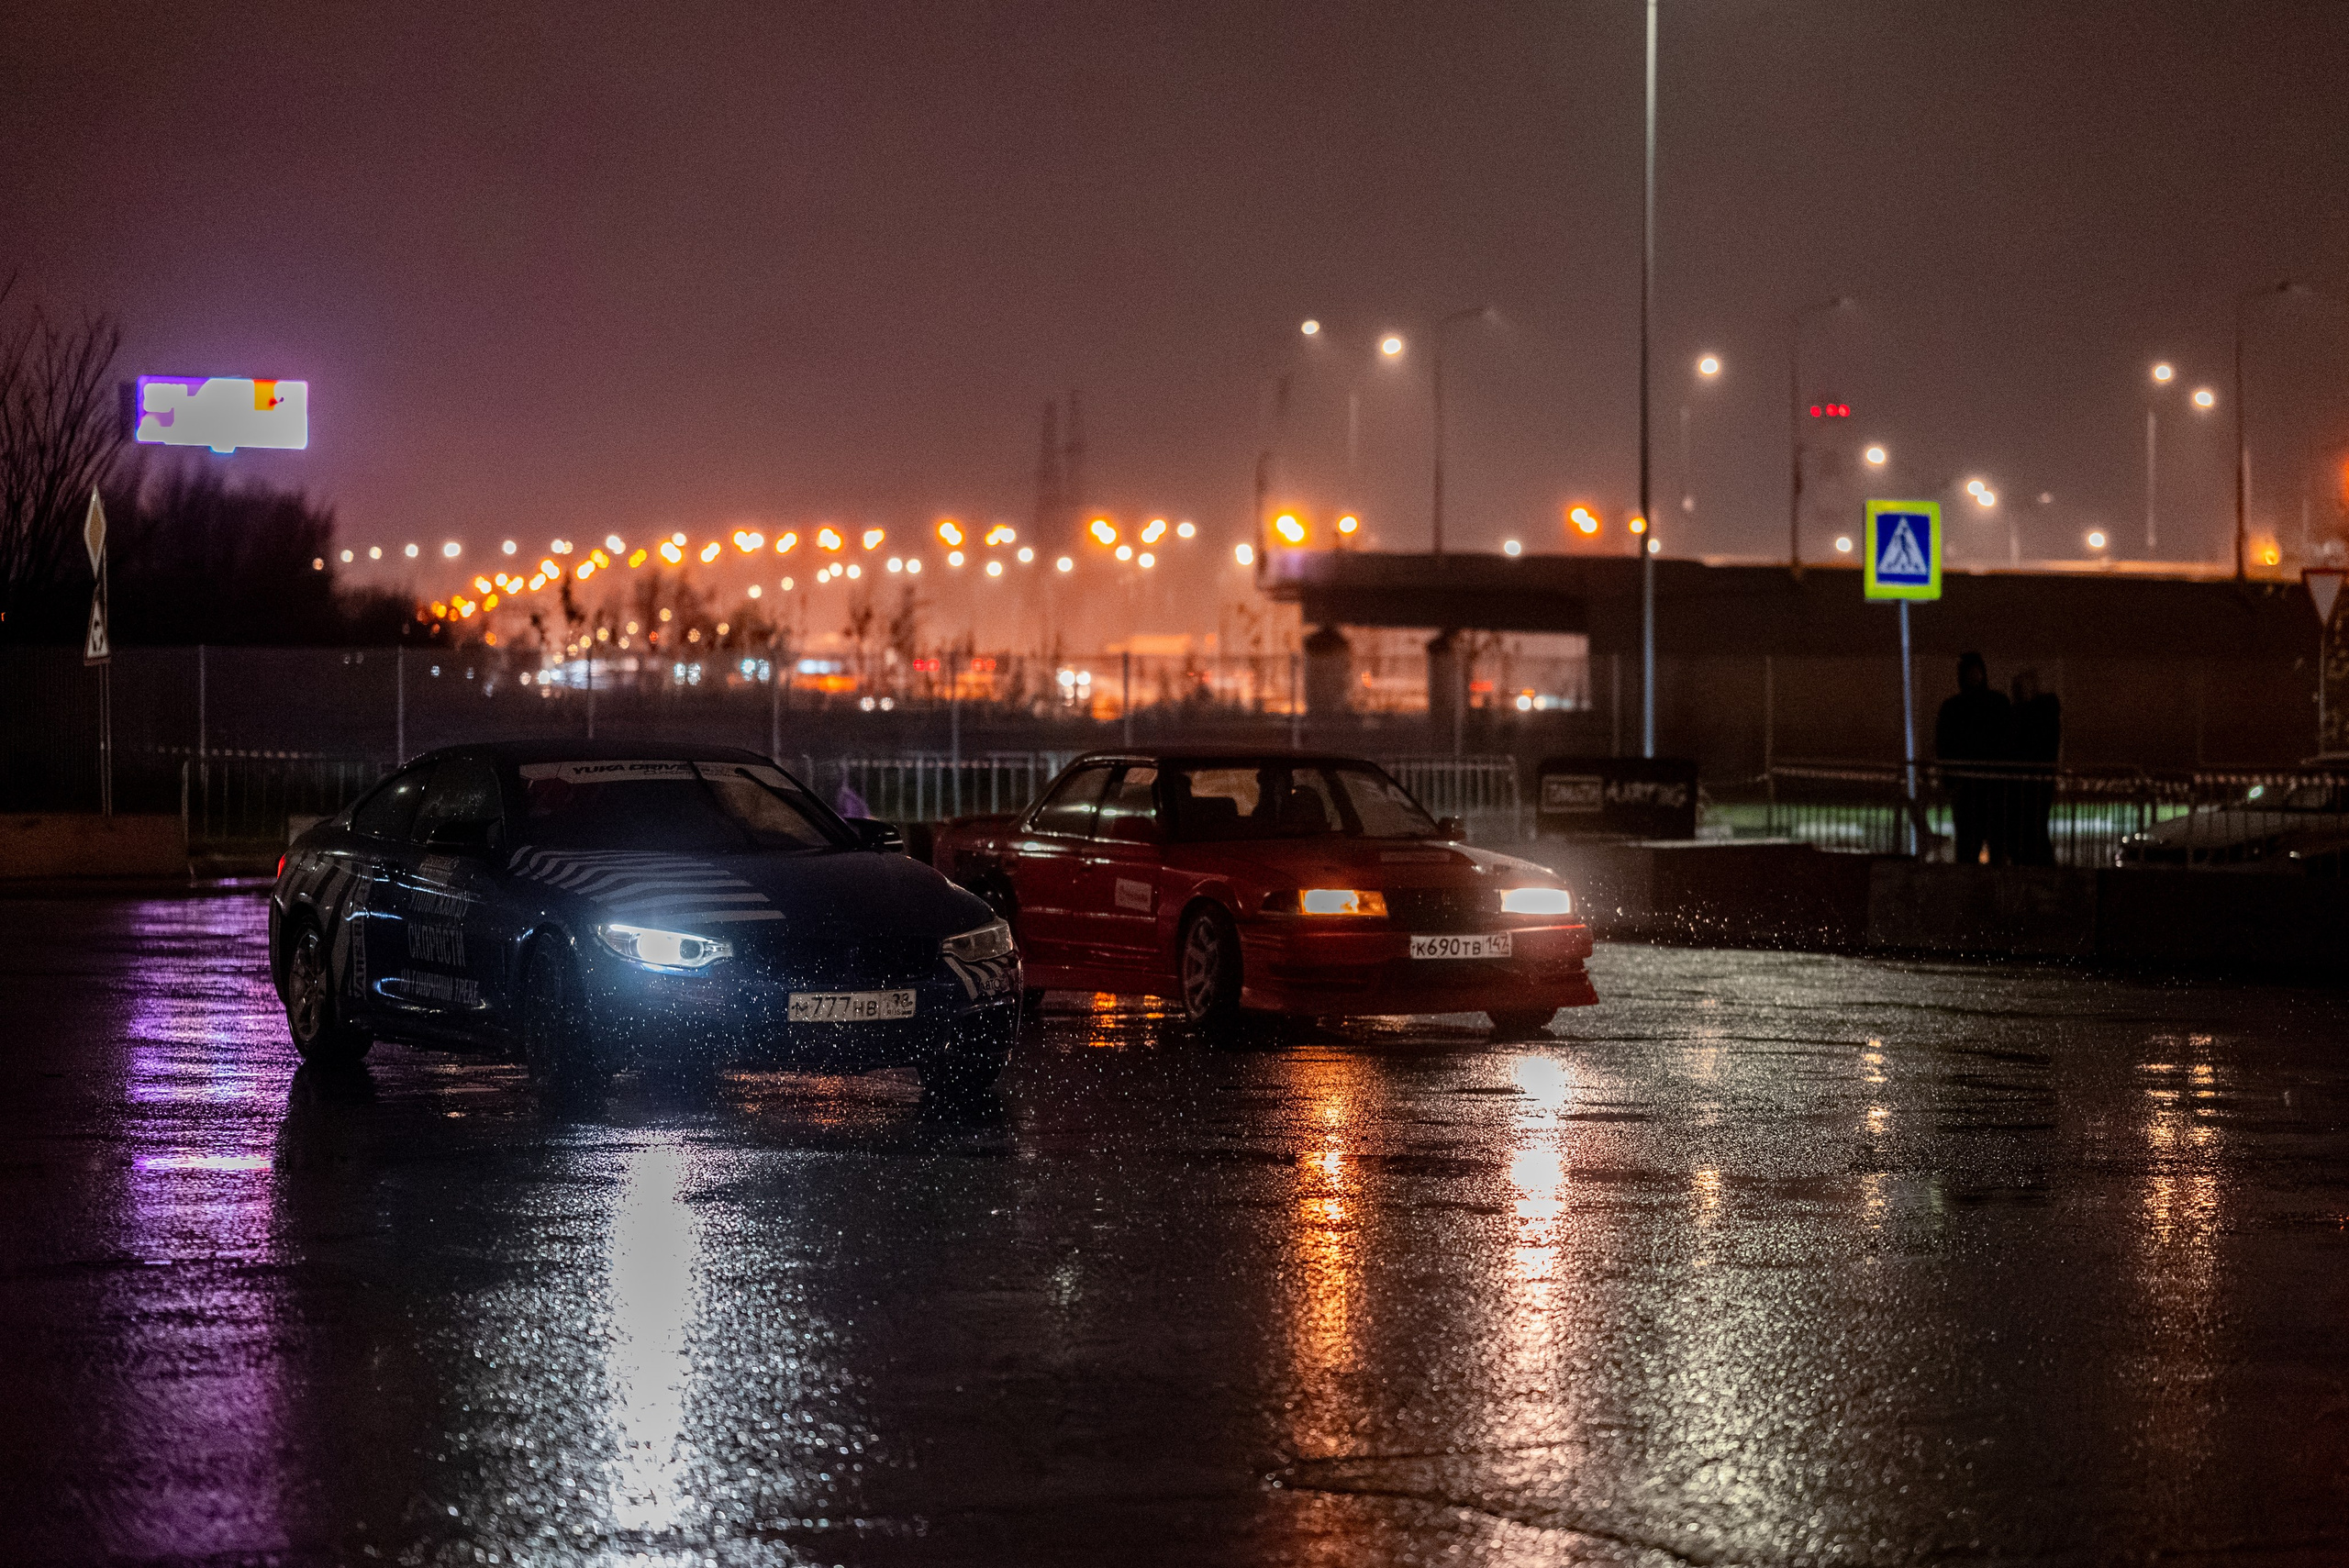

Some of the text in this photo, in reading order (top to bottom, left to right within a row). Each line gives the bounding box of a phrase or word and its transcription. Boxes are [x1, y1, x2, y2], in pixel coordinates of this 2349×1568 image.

[573, 763, 626, 774] YUKA
[407, 923, 466, 967] СКОРОСТИ
[1416, 938, 1482, 956] К690ТВ
